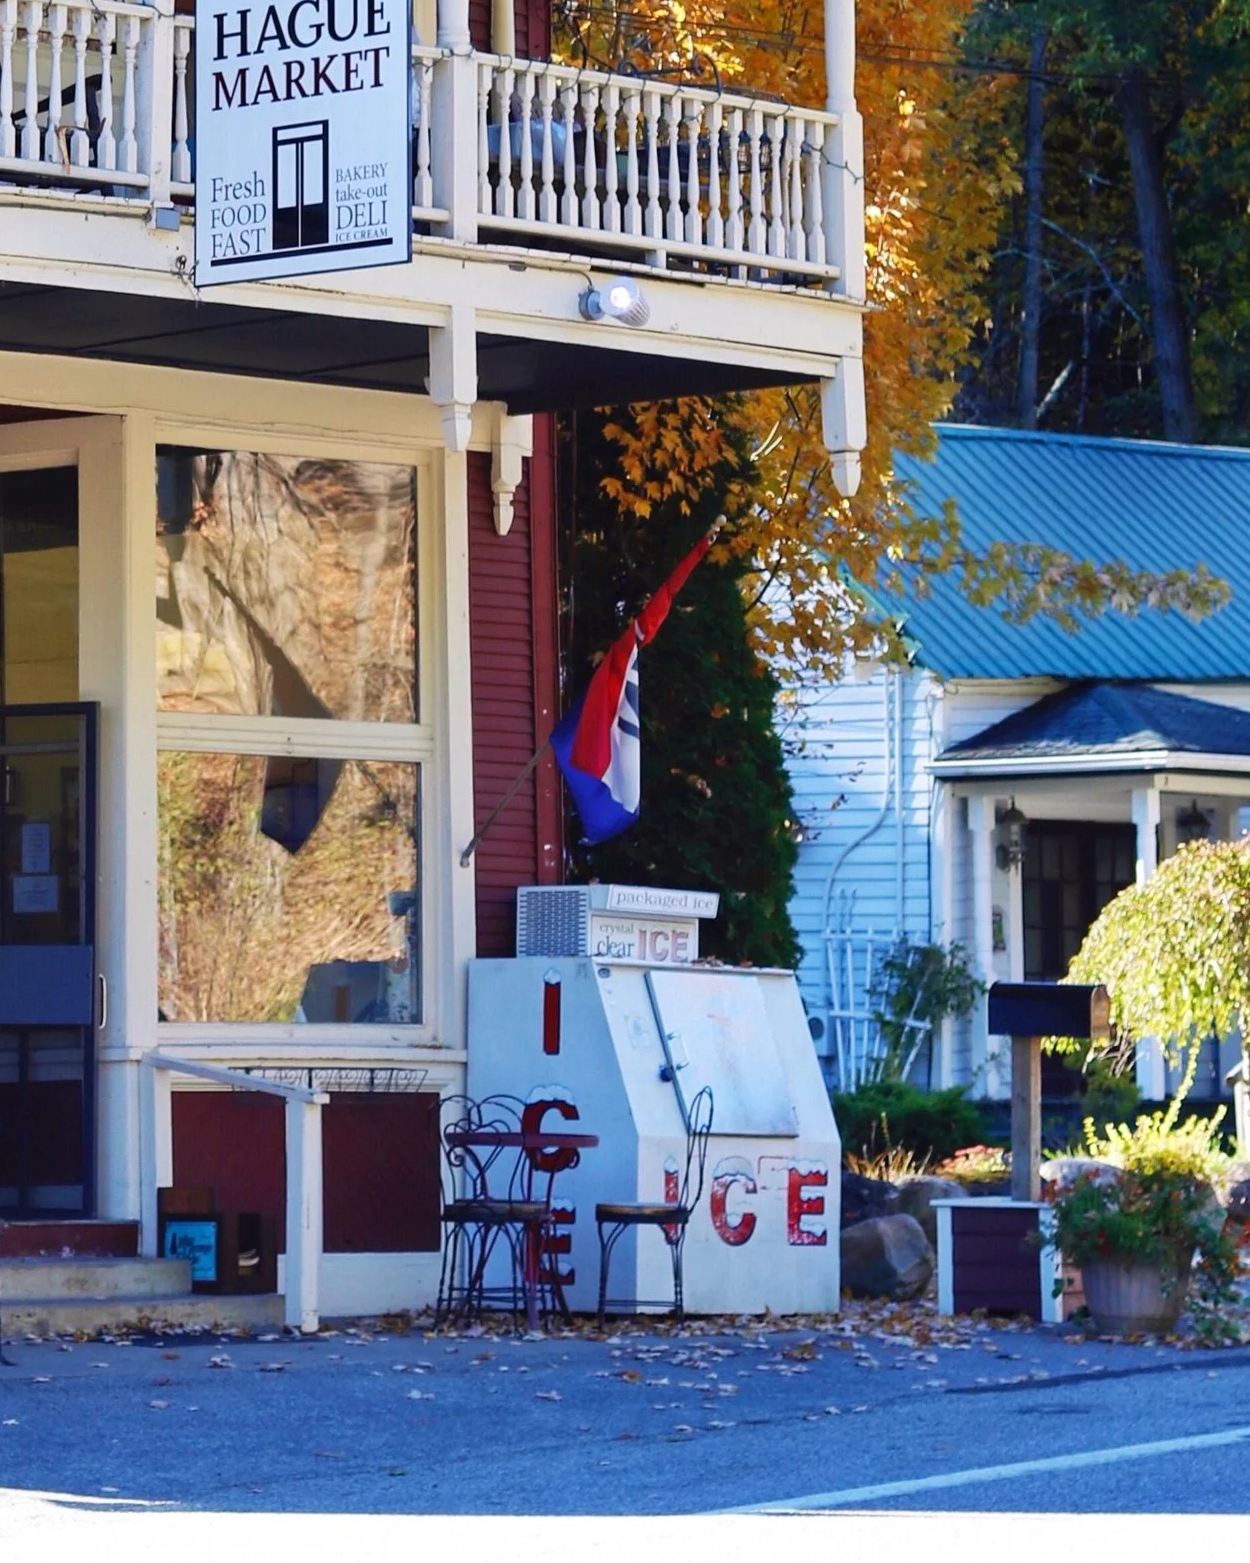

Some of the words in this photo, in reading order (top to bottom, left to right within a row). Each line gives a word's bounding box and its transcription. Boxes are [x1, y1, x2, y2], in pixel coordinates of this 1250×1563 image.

[212, 46, 390, 111] MARKET
[210, 170, 266, 203] Fresh
[335, 162, 388, 183] BAKERY
[335, 182, 388, 203] take-out
[210, 202, 267, 230] FOOD
[336, 199, 388, 230] DELI
[211, 227, 266, 259] FAST
[335, 232, 352, 243] ICE
[353, 227, 388, 241] CREAM
[616, 891, 688, 909] packaged
[693, 896, 714, 910] ice
[599, 922, 634, 935] crystal
[596, 934, 635, 957] clear
[637, 928, 689, 963] ICE
[663, 1155, 829, 1247] ICE
